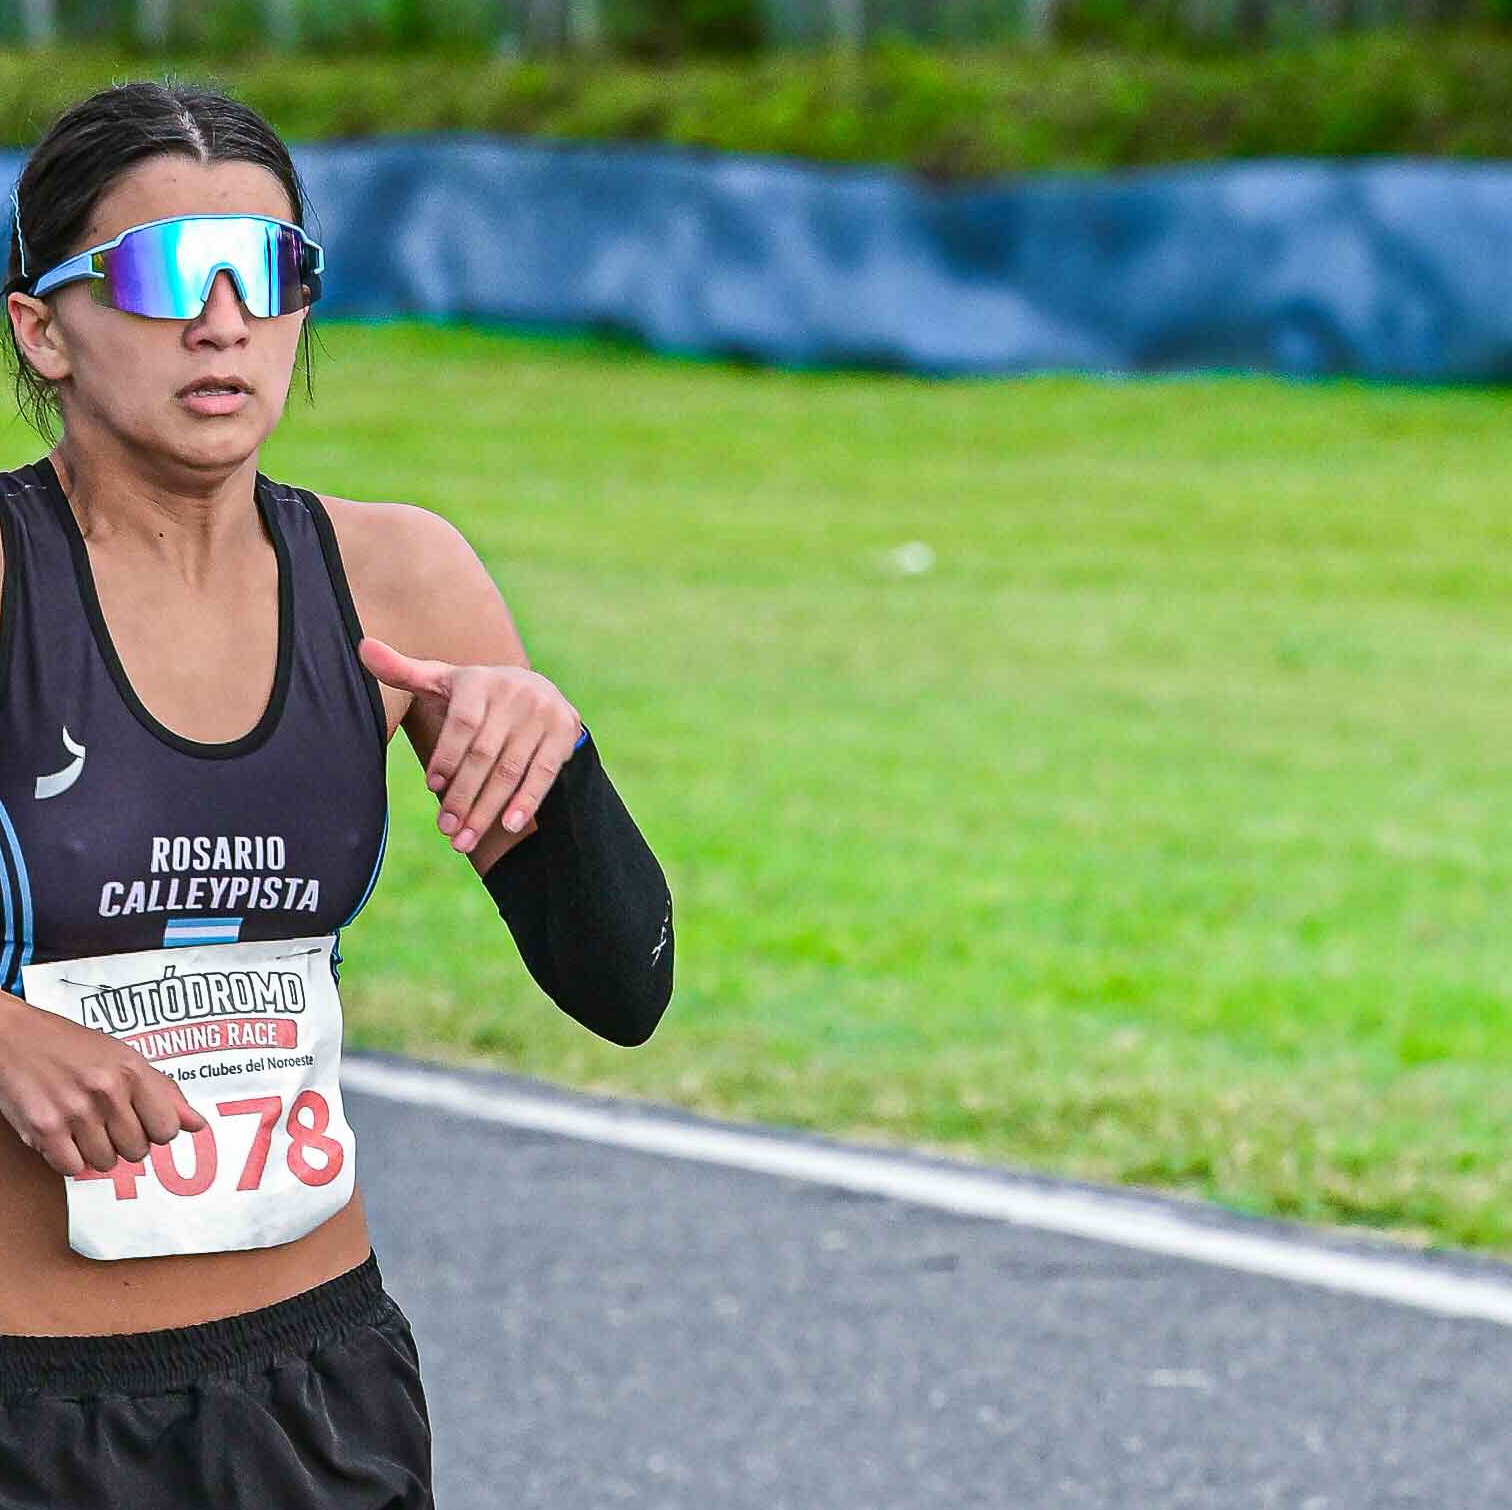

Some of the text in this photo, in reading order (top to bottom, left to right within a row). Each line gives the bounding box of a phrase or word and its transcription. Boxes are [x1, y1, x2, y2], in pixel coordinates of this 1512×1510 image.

[150, 835, 287, 873] ROSARIO
[98, 877, 321, 918] CALLEYPISTA
[81, 964, 307, 1036] AUTÓDROMO
[226, 1021, 279, 1047] RACE
[177, 1067, 197, 1081] los
[199, 1062, 243, 1079] Clubes
[245, 1058, 265, 1073] del
[266, 1054, 314, 1071] Noroeste
